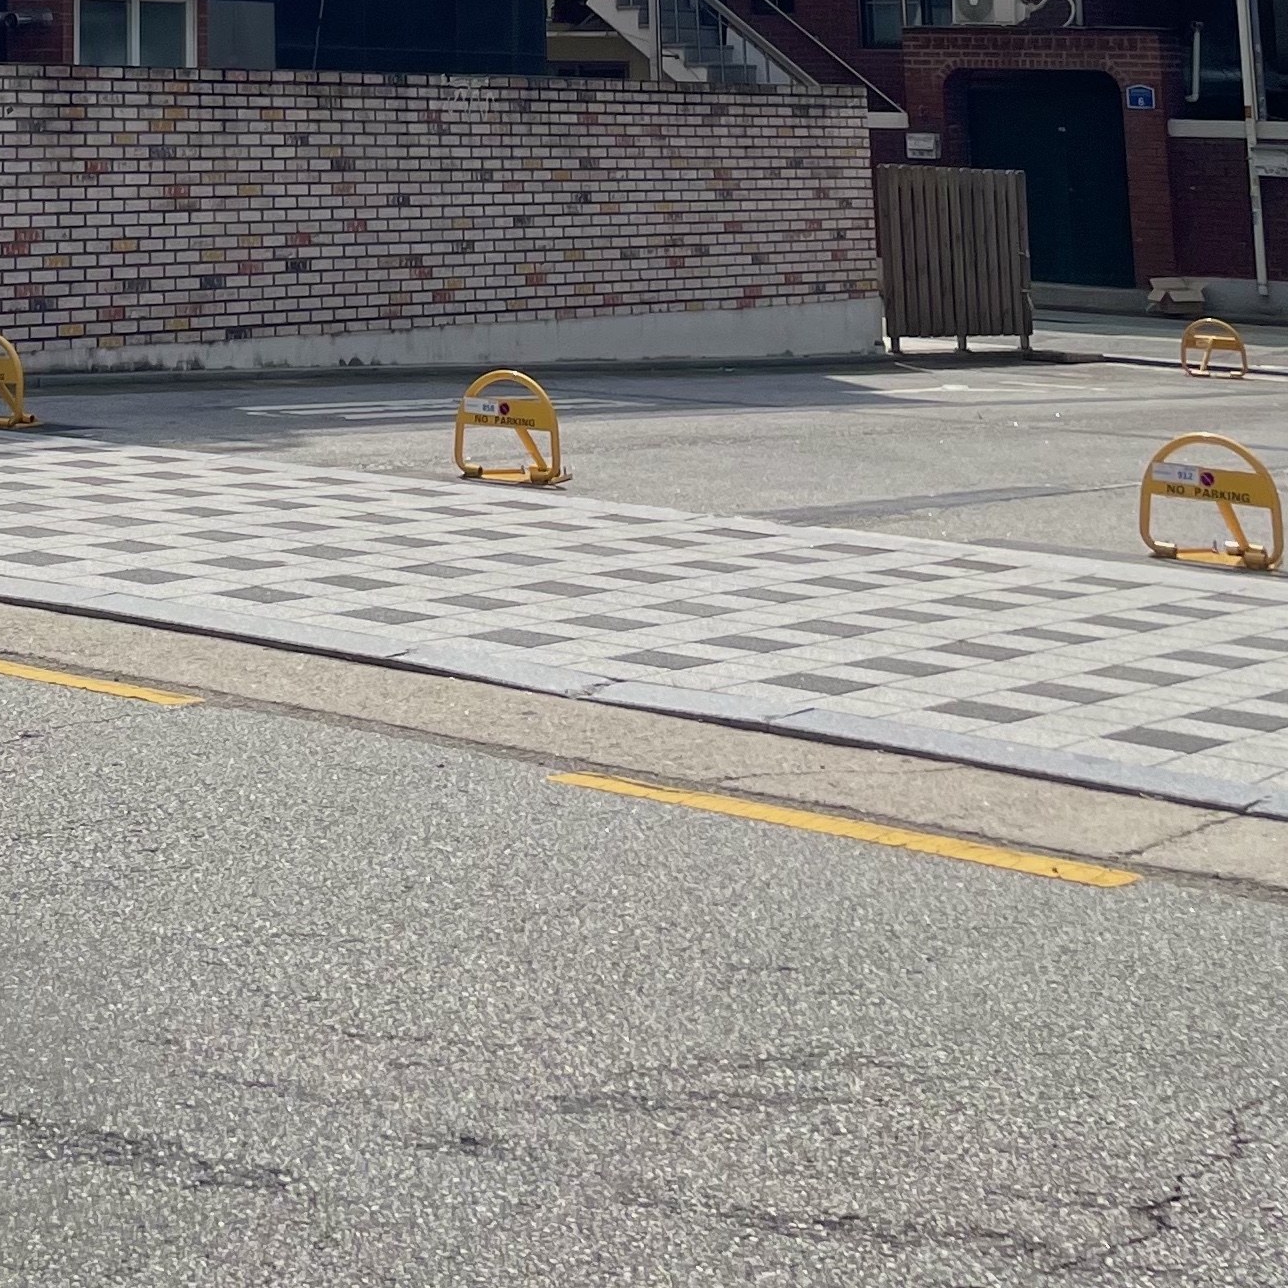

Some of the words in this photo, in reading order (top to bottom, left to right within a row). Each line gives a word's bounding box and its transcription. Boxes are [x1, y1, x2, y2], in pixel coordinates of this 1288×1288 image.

[474, 415, 489, 424] NO
[494, 416, 536, 428] PARKING
[1166, 484, 1185, 496] NO
[1194, 487, 1251, 505] PARKING
